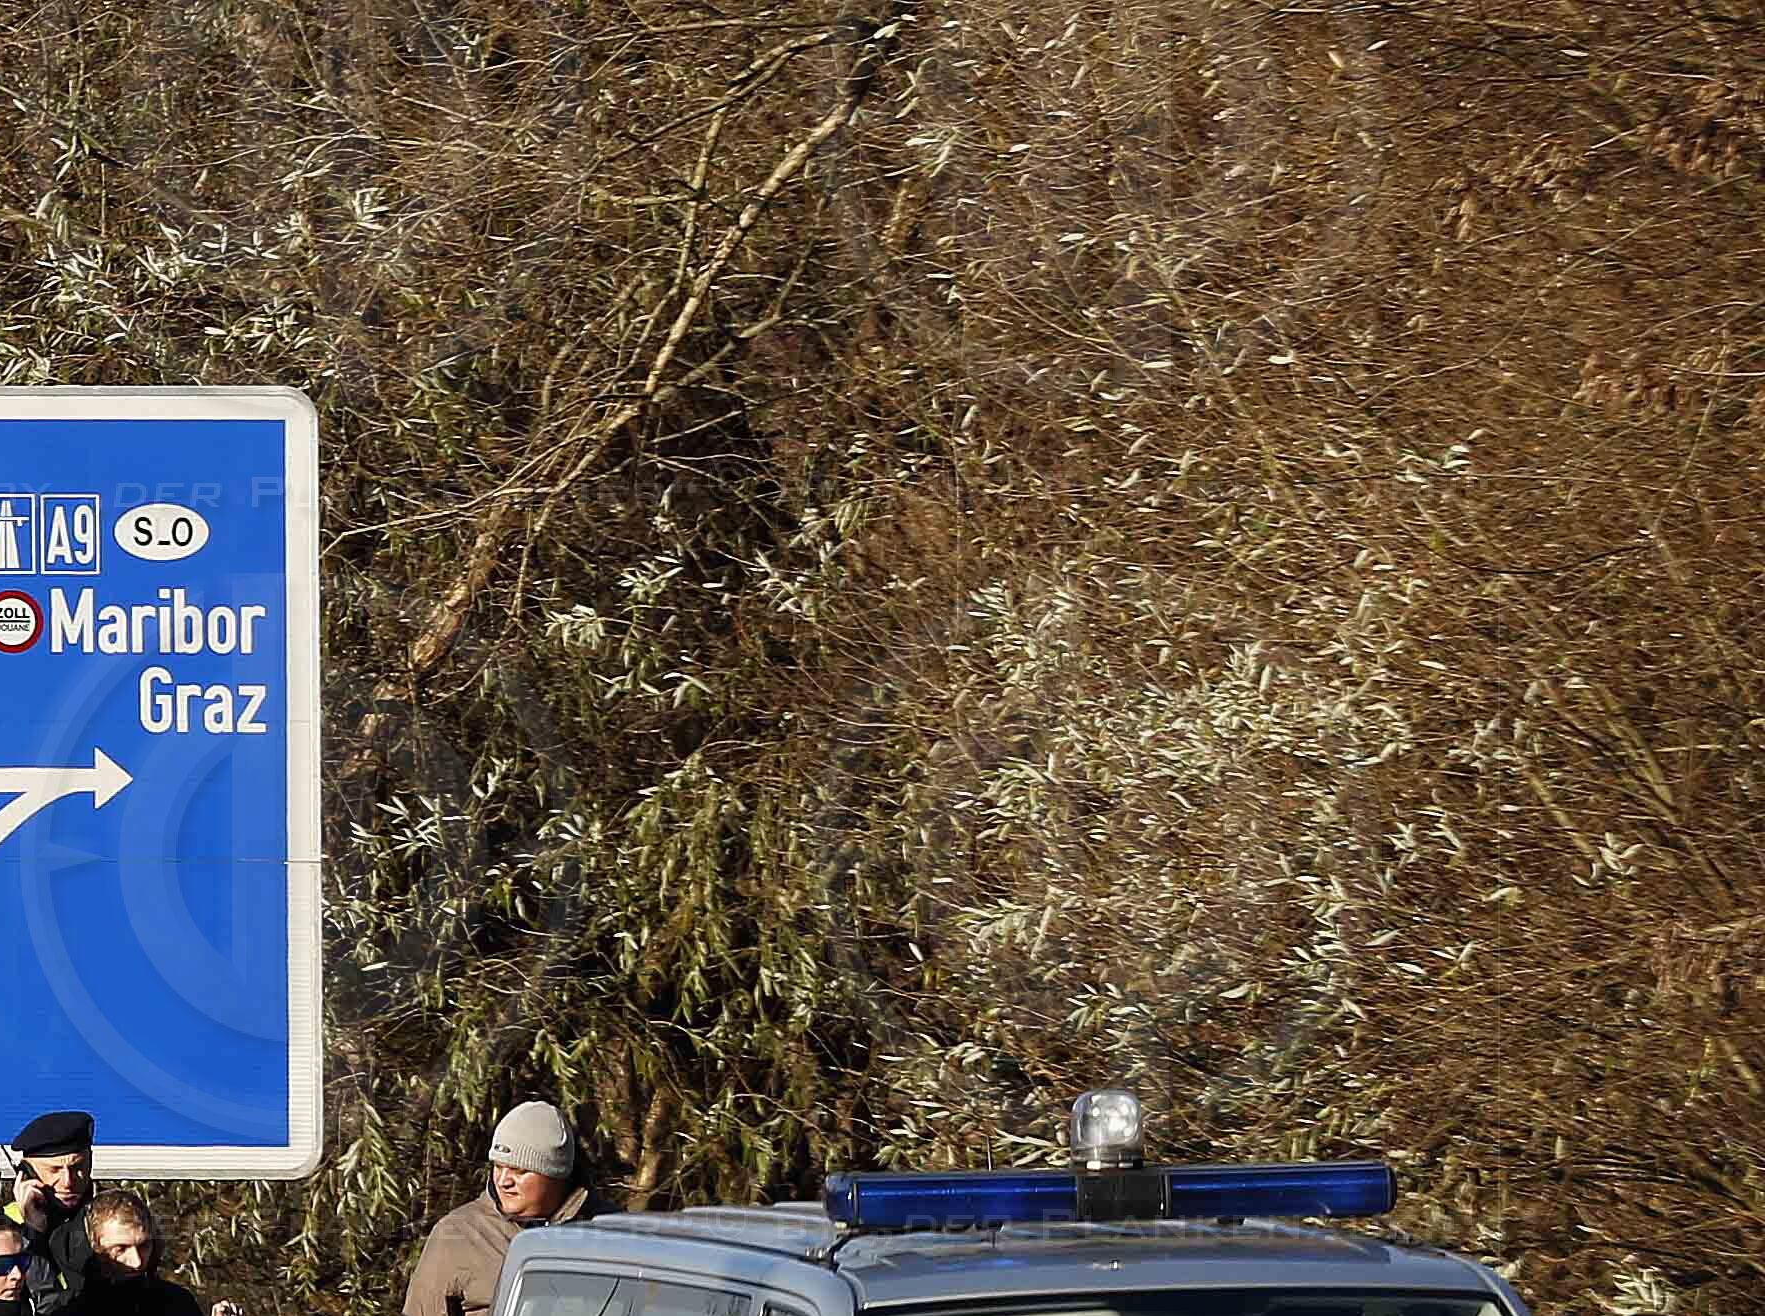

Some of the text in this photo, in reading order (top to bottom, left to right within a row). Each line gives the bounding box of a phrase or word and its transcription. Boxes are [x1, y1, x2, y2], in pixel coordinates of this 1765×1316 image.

[47, 505, 94, 565] A9
[133, 516, 193, 547] SO
[51, 588, 267, 655] Maribor
[140, 666, 267, 733] Graz
